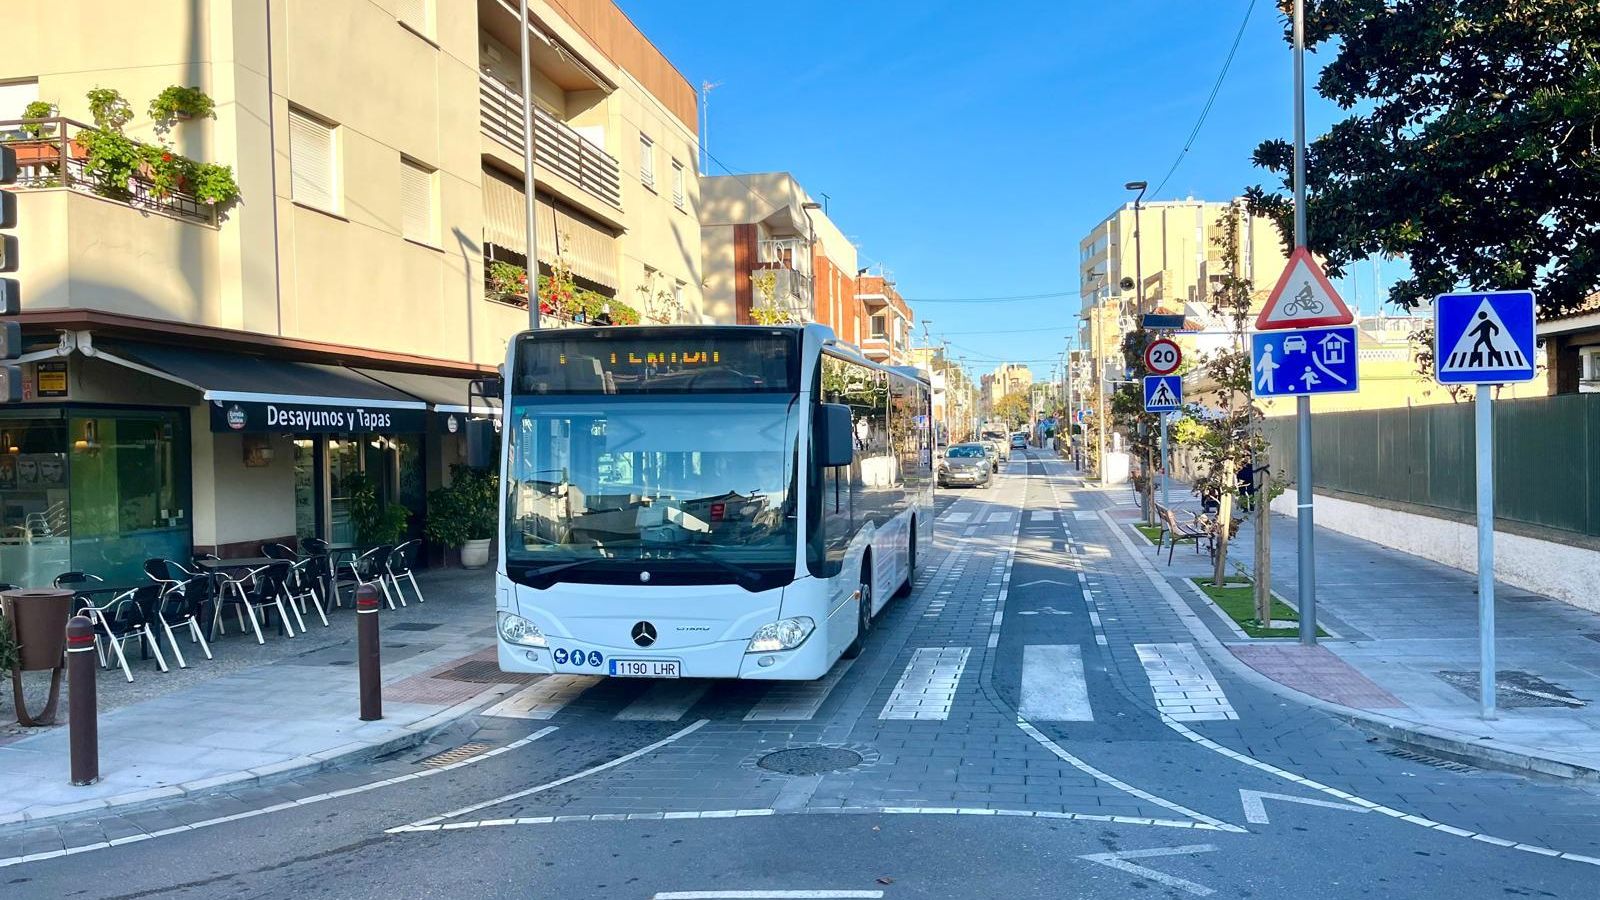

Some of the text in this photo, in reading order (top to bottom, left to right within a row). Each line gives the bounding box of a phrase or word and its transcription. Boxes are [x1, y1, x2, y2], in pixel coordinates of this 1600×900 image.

[1153, 350, 1175, 363] 20
[267, 405, 344, 431] Desayunos
[346, 411, 355, 431] y
[356, 408, 391, 431] Tapas
[620, 662, 676, 675] 1190 LHR
